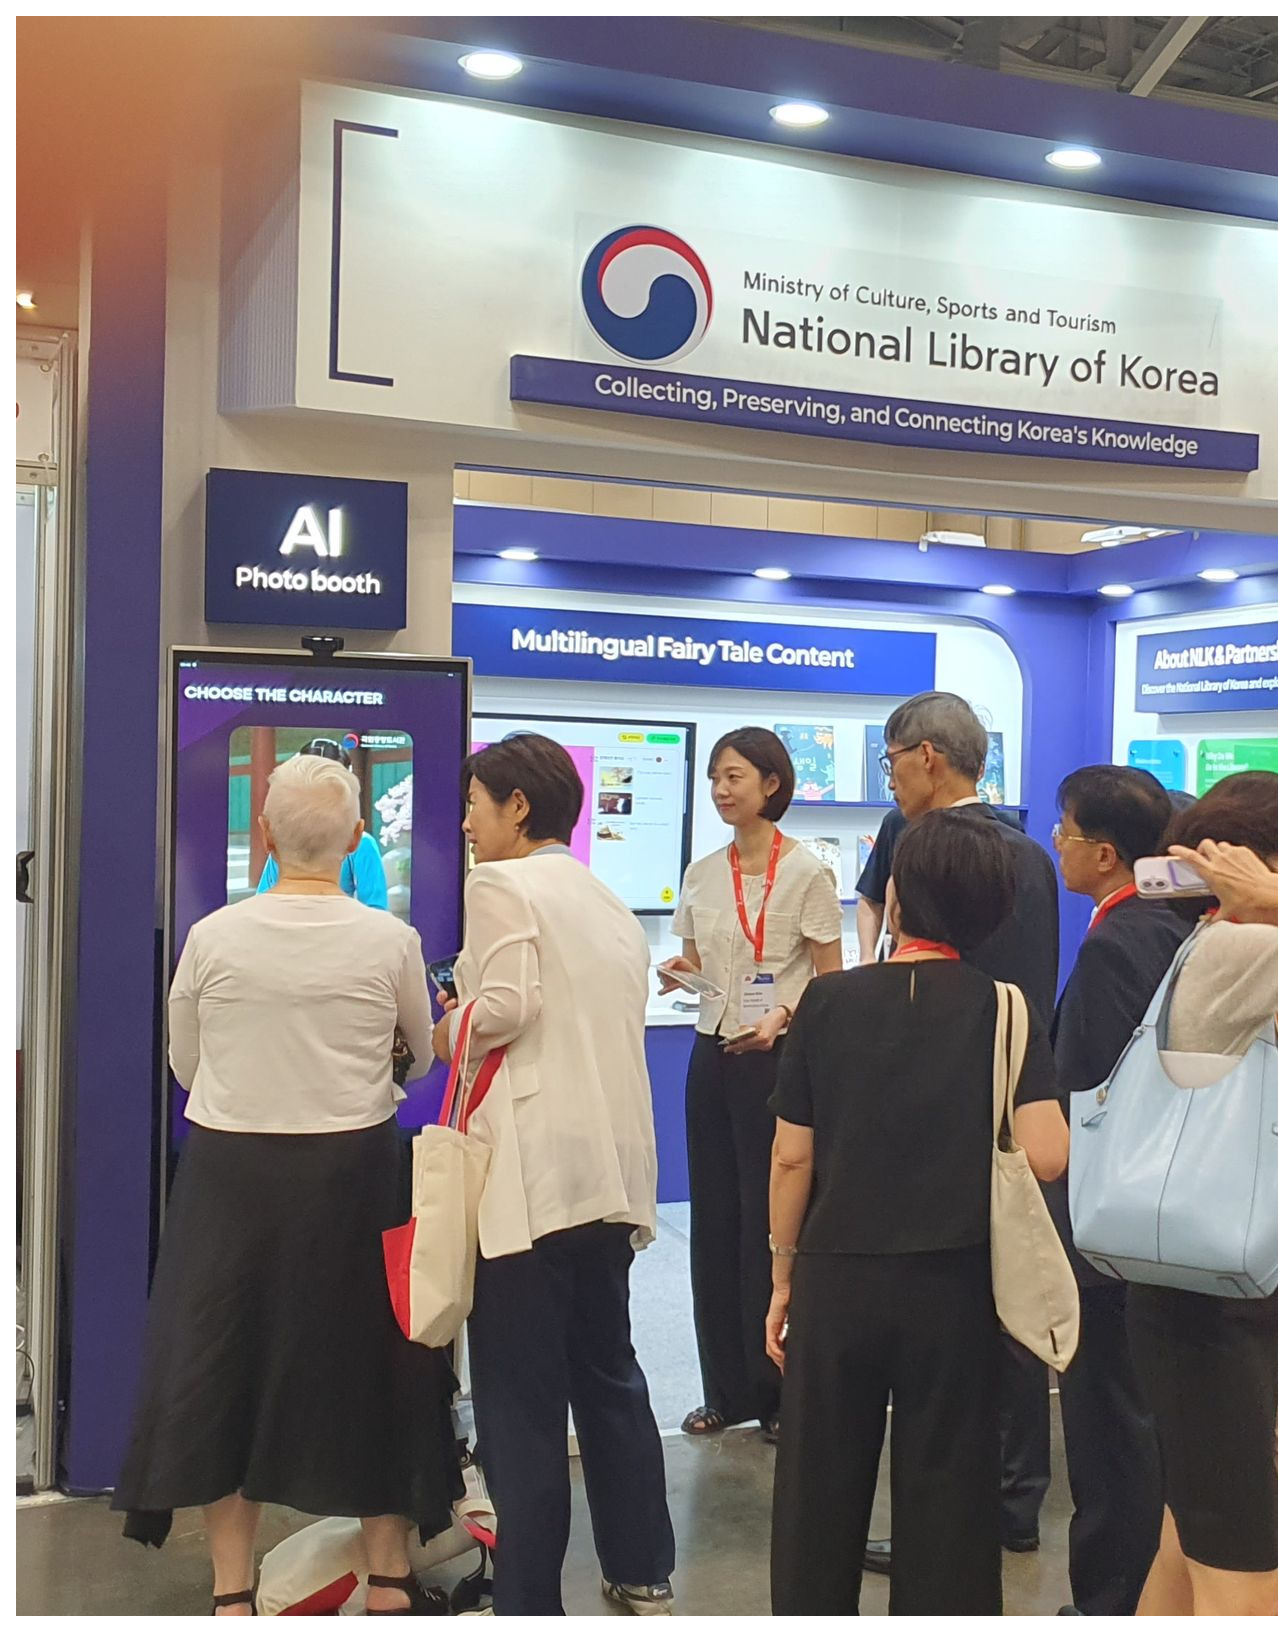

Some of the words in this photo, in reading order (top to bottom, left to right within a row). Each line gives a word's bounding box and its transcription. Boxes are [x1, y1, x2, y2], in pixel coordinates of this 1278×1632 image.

[743, 270, 824, 303] Ministry
[829, 284, 850, 301] of
[856, 285, 931, 315] Culture,
[936, 295, 998, 319] Sports
[1005, 307, 1041, 325] and
[1046, 309, 1116, 334] Tourism
[742, 307, 912, 363] National
[929, 330, 1060, 388] Library
[1069, 349, 1107, 385] of
[1119, 353, 1220, 397] Korea
[594, 373, 718, 411] Collecting,
[722, 388, 847, 425] Preserving,
[850, 405, 890, 426] and
[894, 407, 1013, 442] Connecting
[1017, 419, 1088, 446] Korea's
[1091, 427, 1199, 459] Knowledge
[278, 503, 344, 557] AI
[235, 566, 308, 591] Photo
[310, 567, 381, 595] booth
[511, 628, 654, 661] Multilingual
[657, 637, 716, 666] Fairy
[716, 639, 764, 664] Tale
[765, 643, 855, 668] Content
[1153, 648, 1189, 670] About
[1189, 645, 1215, 668] NLK
[1215, 644, 1225, 666] &
[183, 685, 253, 701] CHOOSE
[254, 687, 288, 702] THE
[288, 688, 384, 705] CHARACTER
[1201, 680, 1223, 694] Library
[1248, 676, 1262, 689] and
